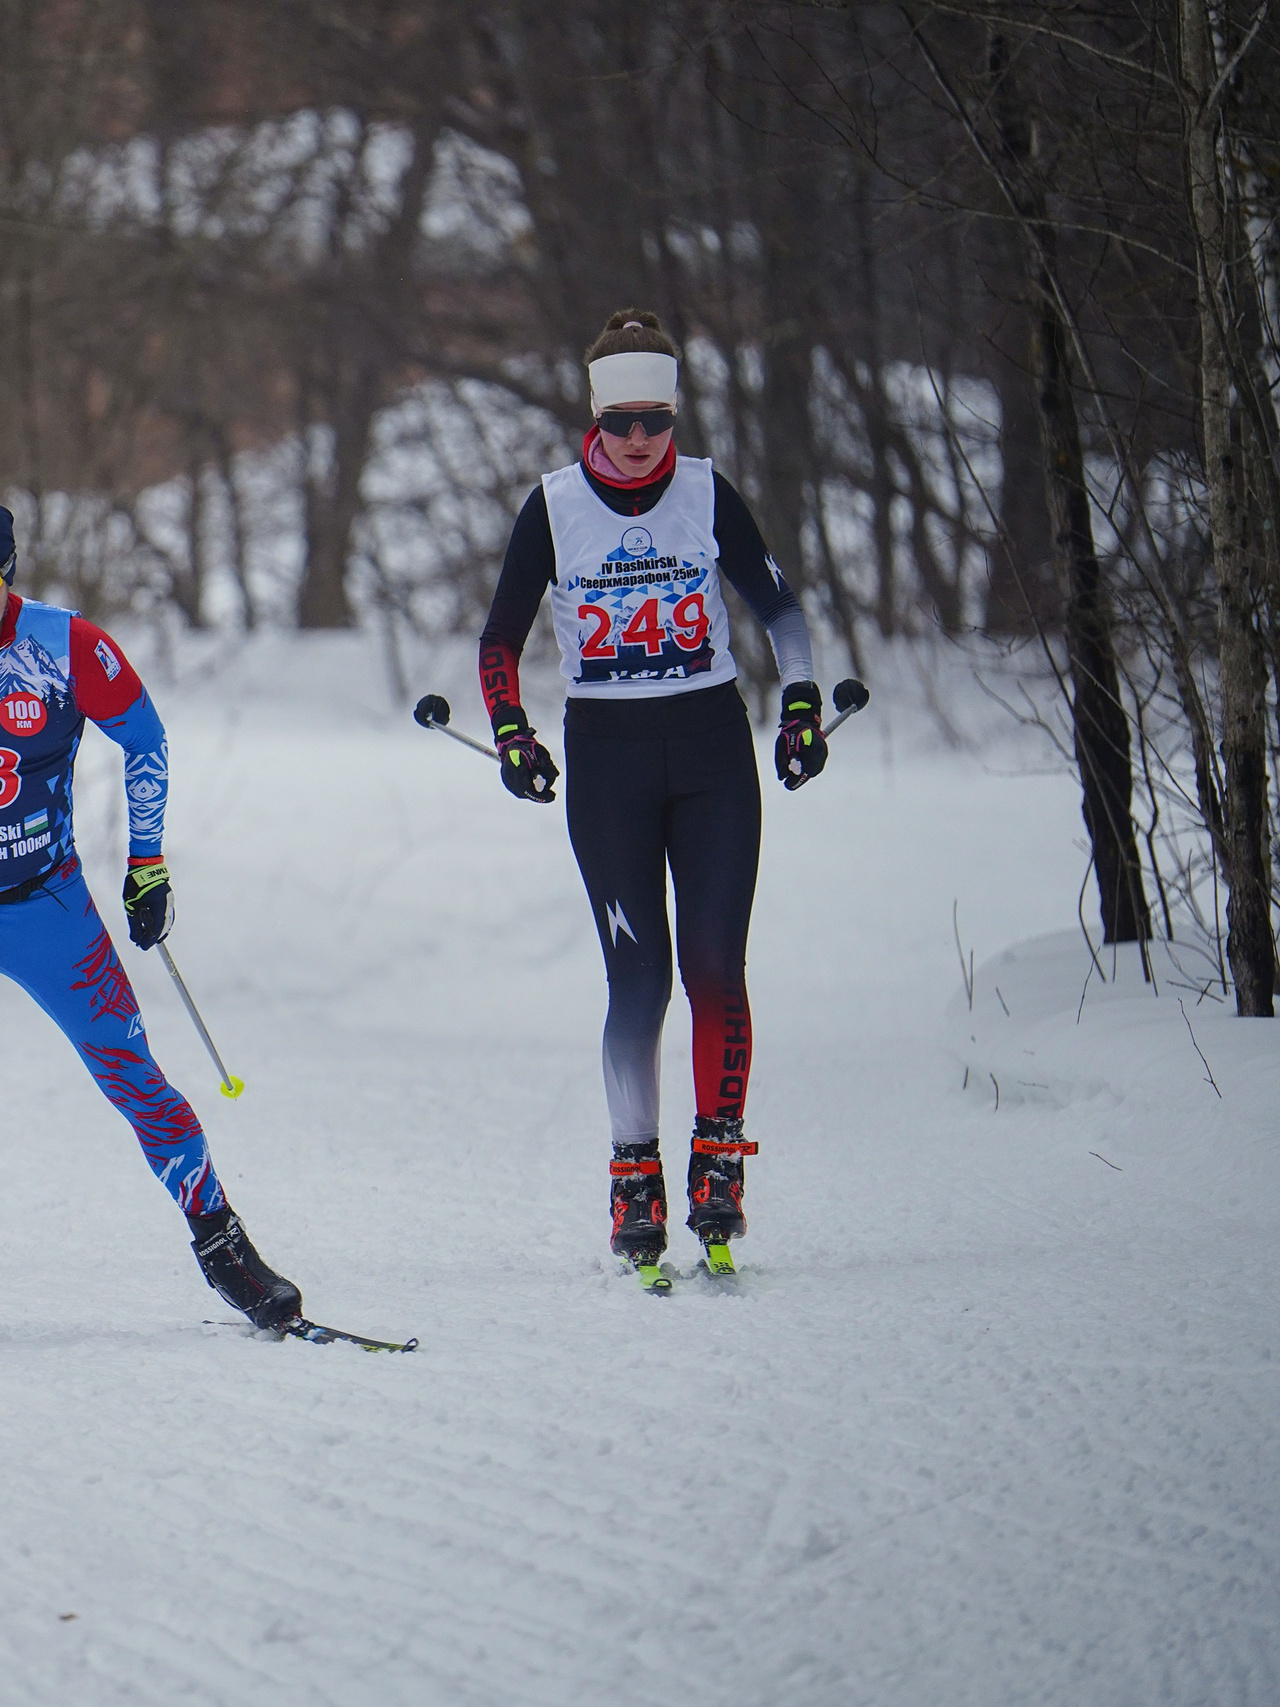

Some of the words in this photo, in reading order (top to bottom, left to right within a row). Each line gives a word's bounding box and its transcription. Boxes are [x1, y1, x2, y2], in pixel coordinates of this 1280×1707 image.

[601, 563, 613, 575] IV
[615, 556, 677, 573] BashkirSki
[580, 572, 670, 589] Сверхмарафон
[578, 593, 709, 658] 249
[5, 700, 41, 719] 100
[11, 832, 51, 858] 100км
